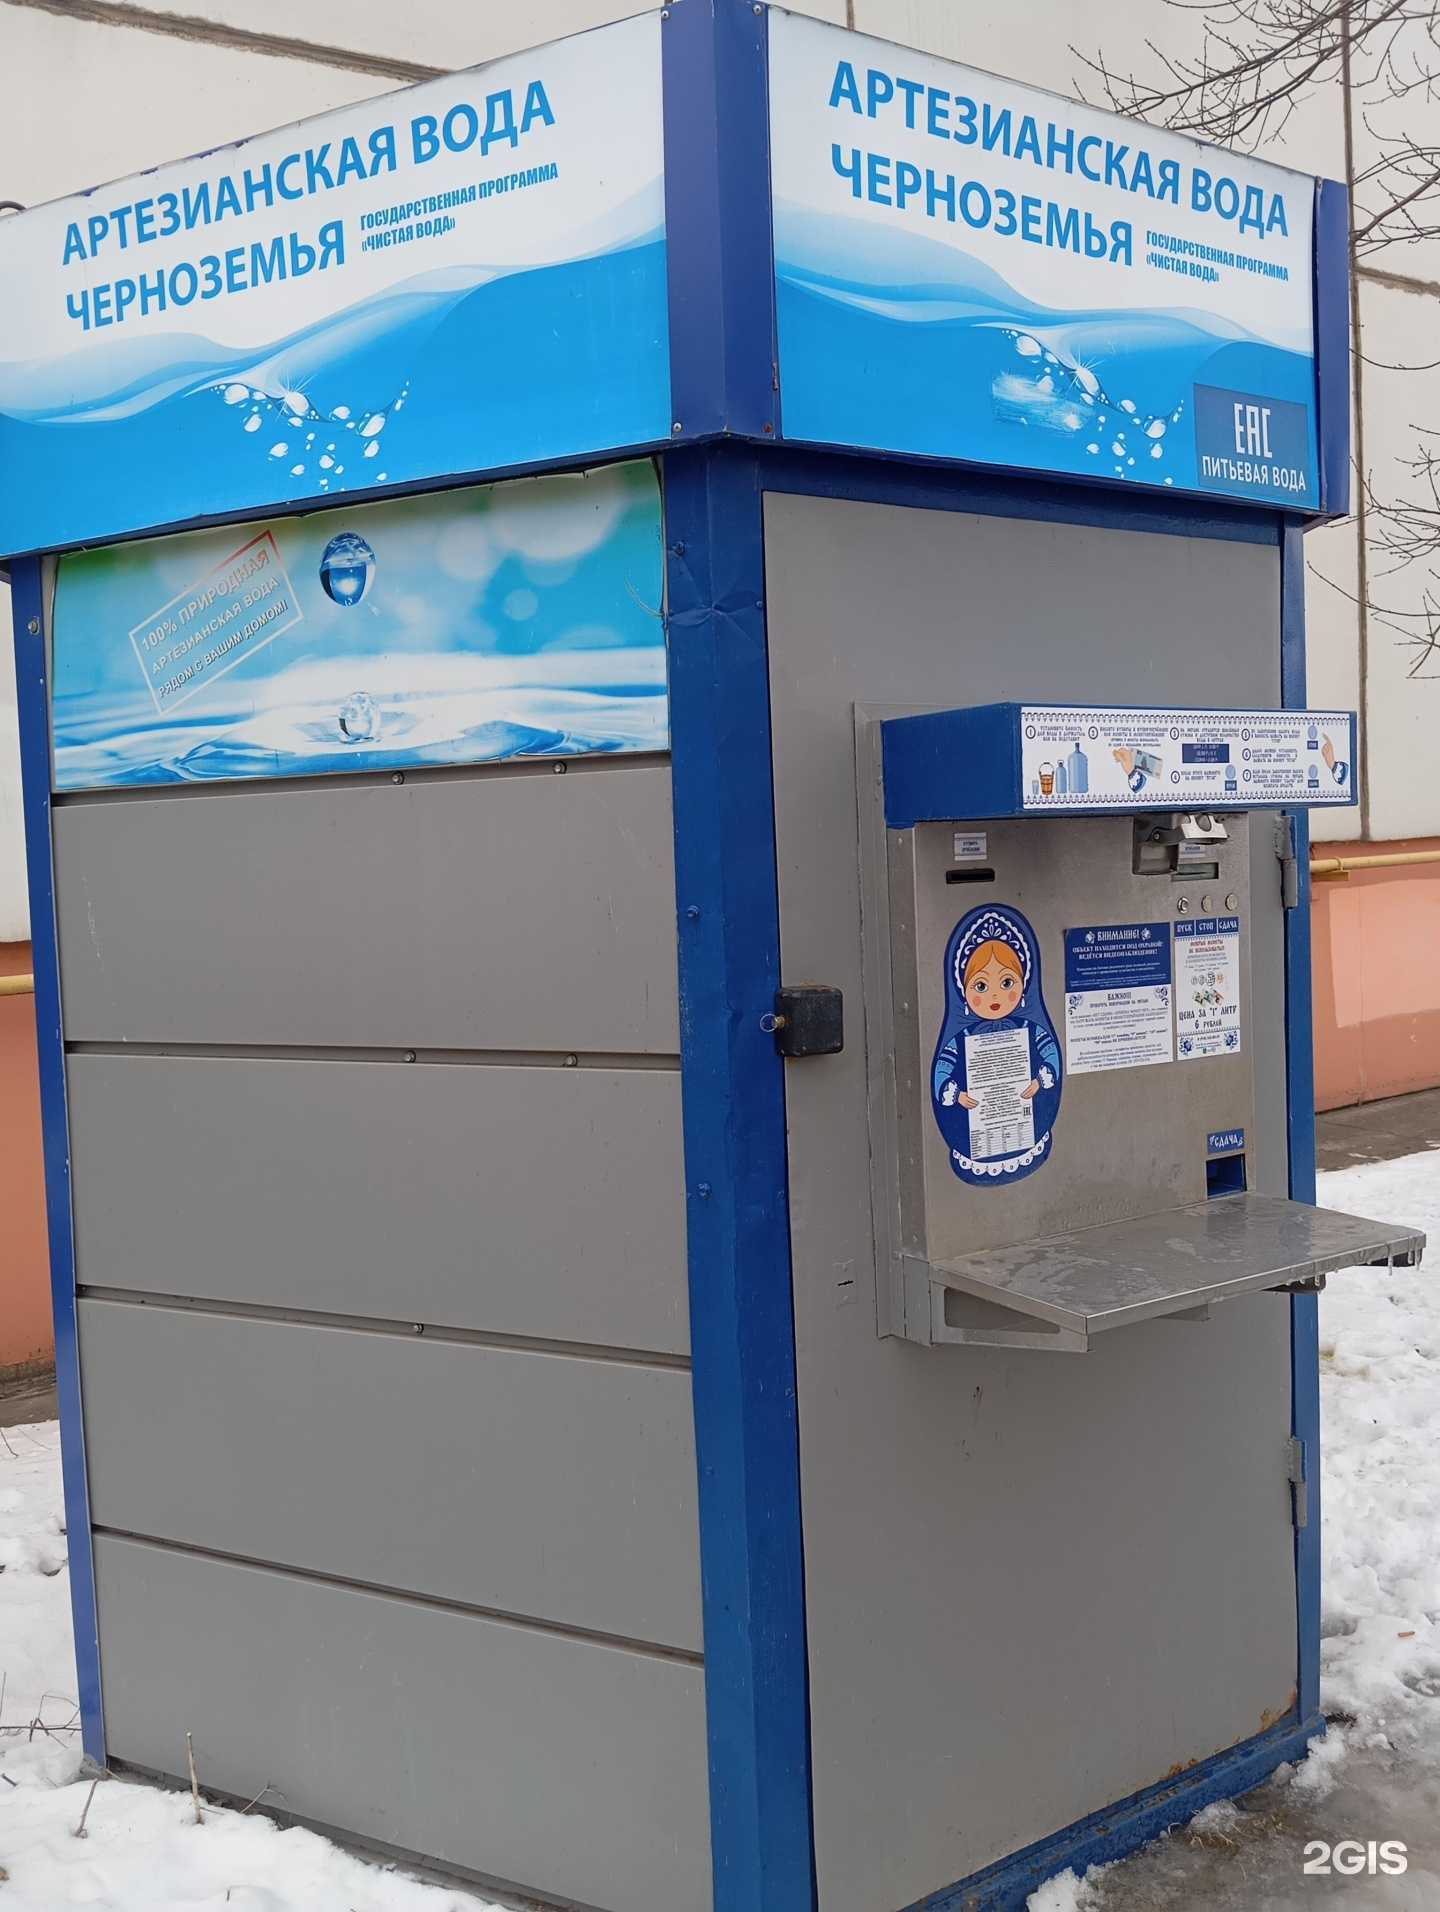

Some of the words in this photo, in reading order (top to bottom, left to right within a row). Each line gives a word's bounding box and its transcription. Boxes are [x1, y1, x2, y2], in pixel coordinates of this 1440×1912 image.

[62, 126, 397, 265] АРТЕЗИАНСКАЯ
[411, 80, 555, 164] ВОДА
[829, 60, 1181, 205] АРТЕЗИАНСКАЯ
[1191, 167, 1289, 240] ВОДА
[360, 185, 476, 231] ГОСУДАРСТВЕННАЯ
[478, 162, 559, 199] ПРОГРАММА
[831, 143, 1132, 266] ЧЕРНОЗЕМЬЯ
[361, 224, 414, 252] «ЧИСТАЯ
[416, 215, 456, 239] ВОДА»
[1146, 230, 1235, 268] ГОСУДАРСТВЕННАЯ
[1236, 255, 1289, 282] ПРОГРАММА
[66, 220, 345, 331] ЧЕРНОЗЕМЬЯ
[1202, 455, 1269, 485] ПИТЬЕВАЯ
[1272, 466, 1306, 493] ВОДА
[141, 617, 177, 652] 100%
[178, 549, 270, 625] ПРИРОДНАЯ
[152, 602, 243, 676] АРТЕЗИАНСКАЯ
[244, 576, 280, 609] ВОДА
[159, 664, 196, 698] РЯДОМ
[195, 660, 204, 672] С
[205, 631, 243, 666] ВАШИМ
[243, 599, 289, 640] ДОМОМ!
[1199, 922, 1213, 931] СТОП
[1219, 919, 1237, 930] СДАЧА
[1179, 1010, 1195, 1021] ЦЕНА
[1198, 1008, 1206, 1018] ЗА
[1214, 1133, 1239, 1148] СДАЧА
